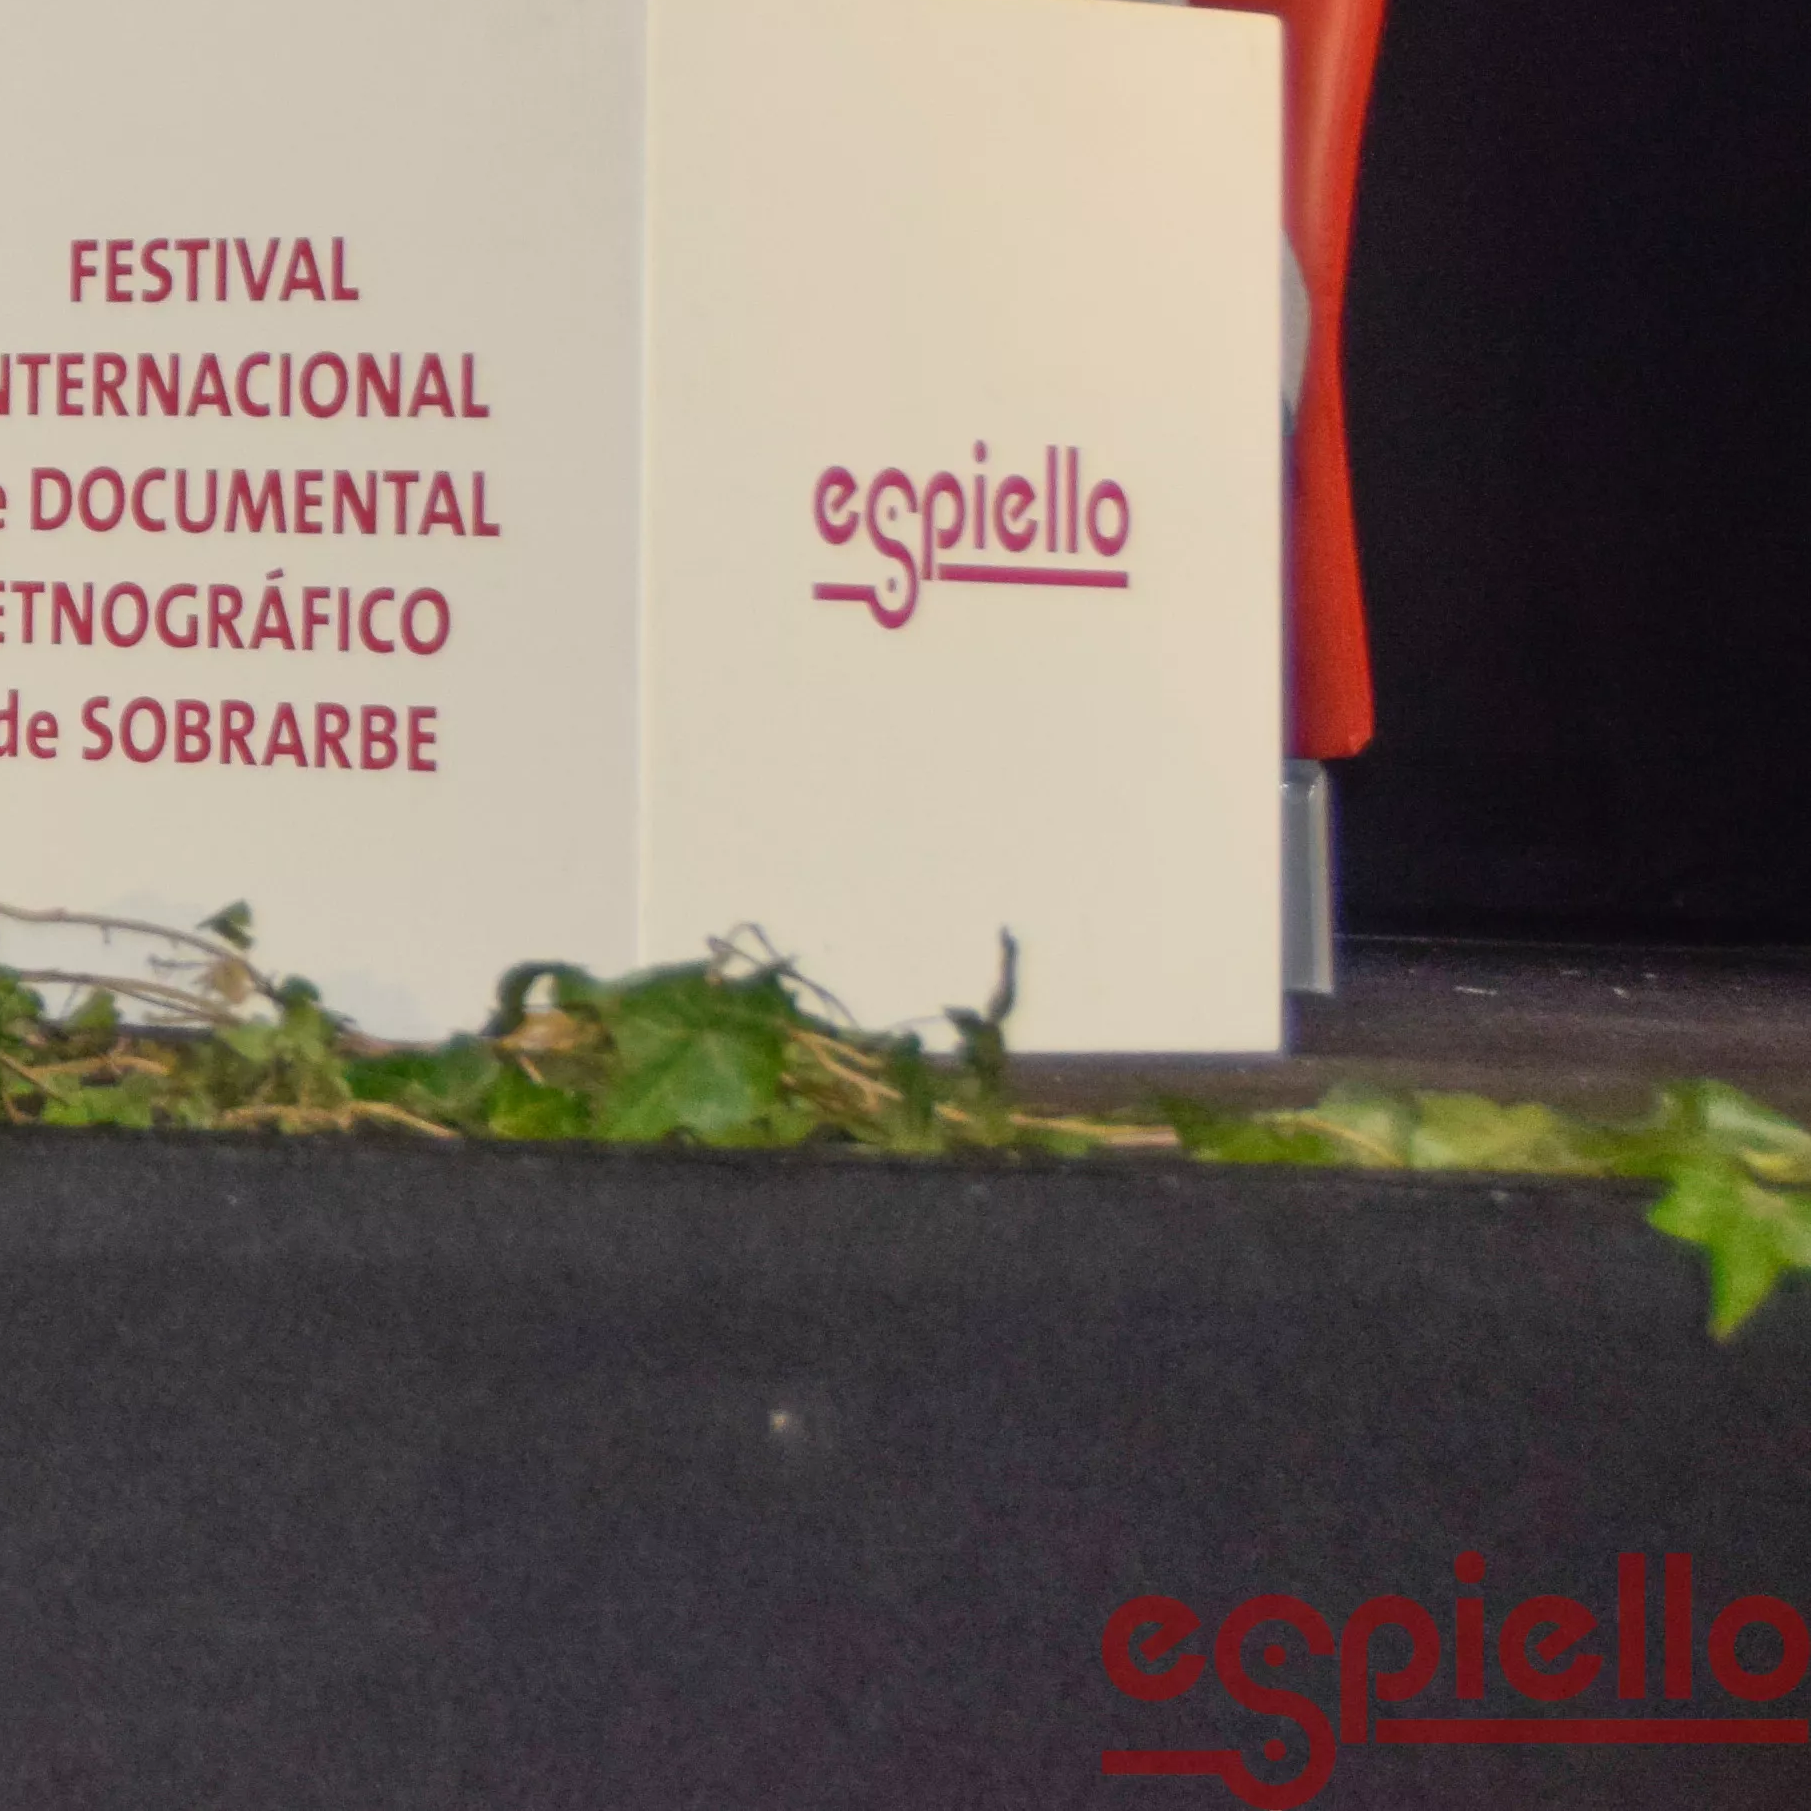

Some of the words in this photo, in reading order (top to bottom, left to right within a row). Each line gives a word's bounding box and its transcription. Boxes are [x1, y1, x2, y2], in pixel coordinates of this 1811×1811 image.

[69, 236, 360, 304] FESTIVAL
[30, 465, 500, 538] DOCUMENTAL
[813, 439, 1131, 631] espiello
[80, 696, 438, 772] SOBRARBE
